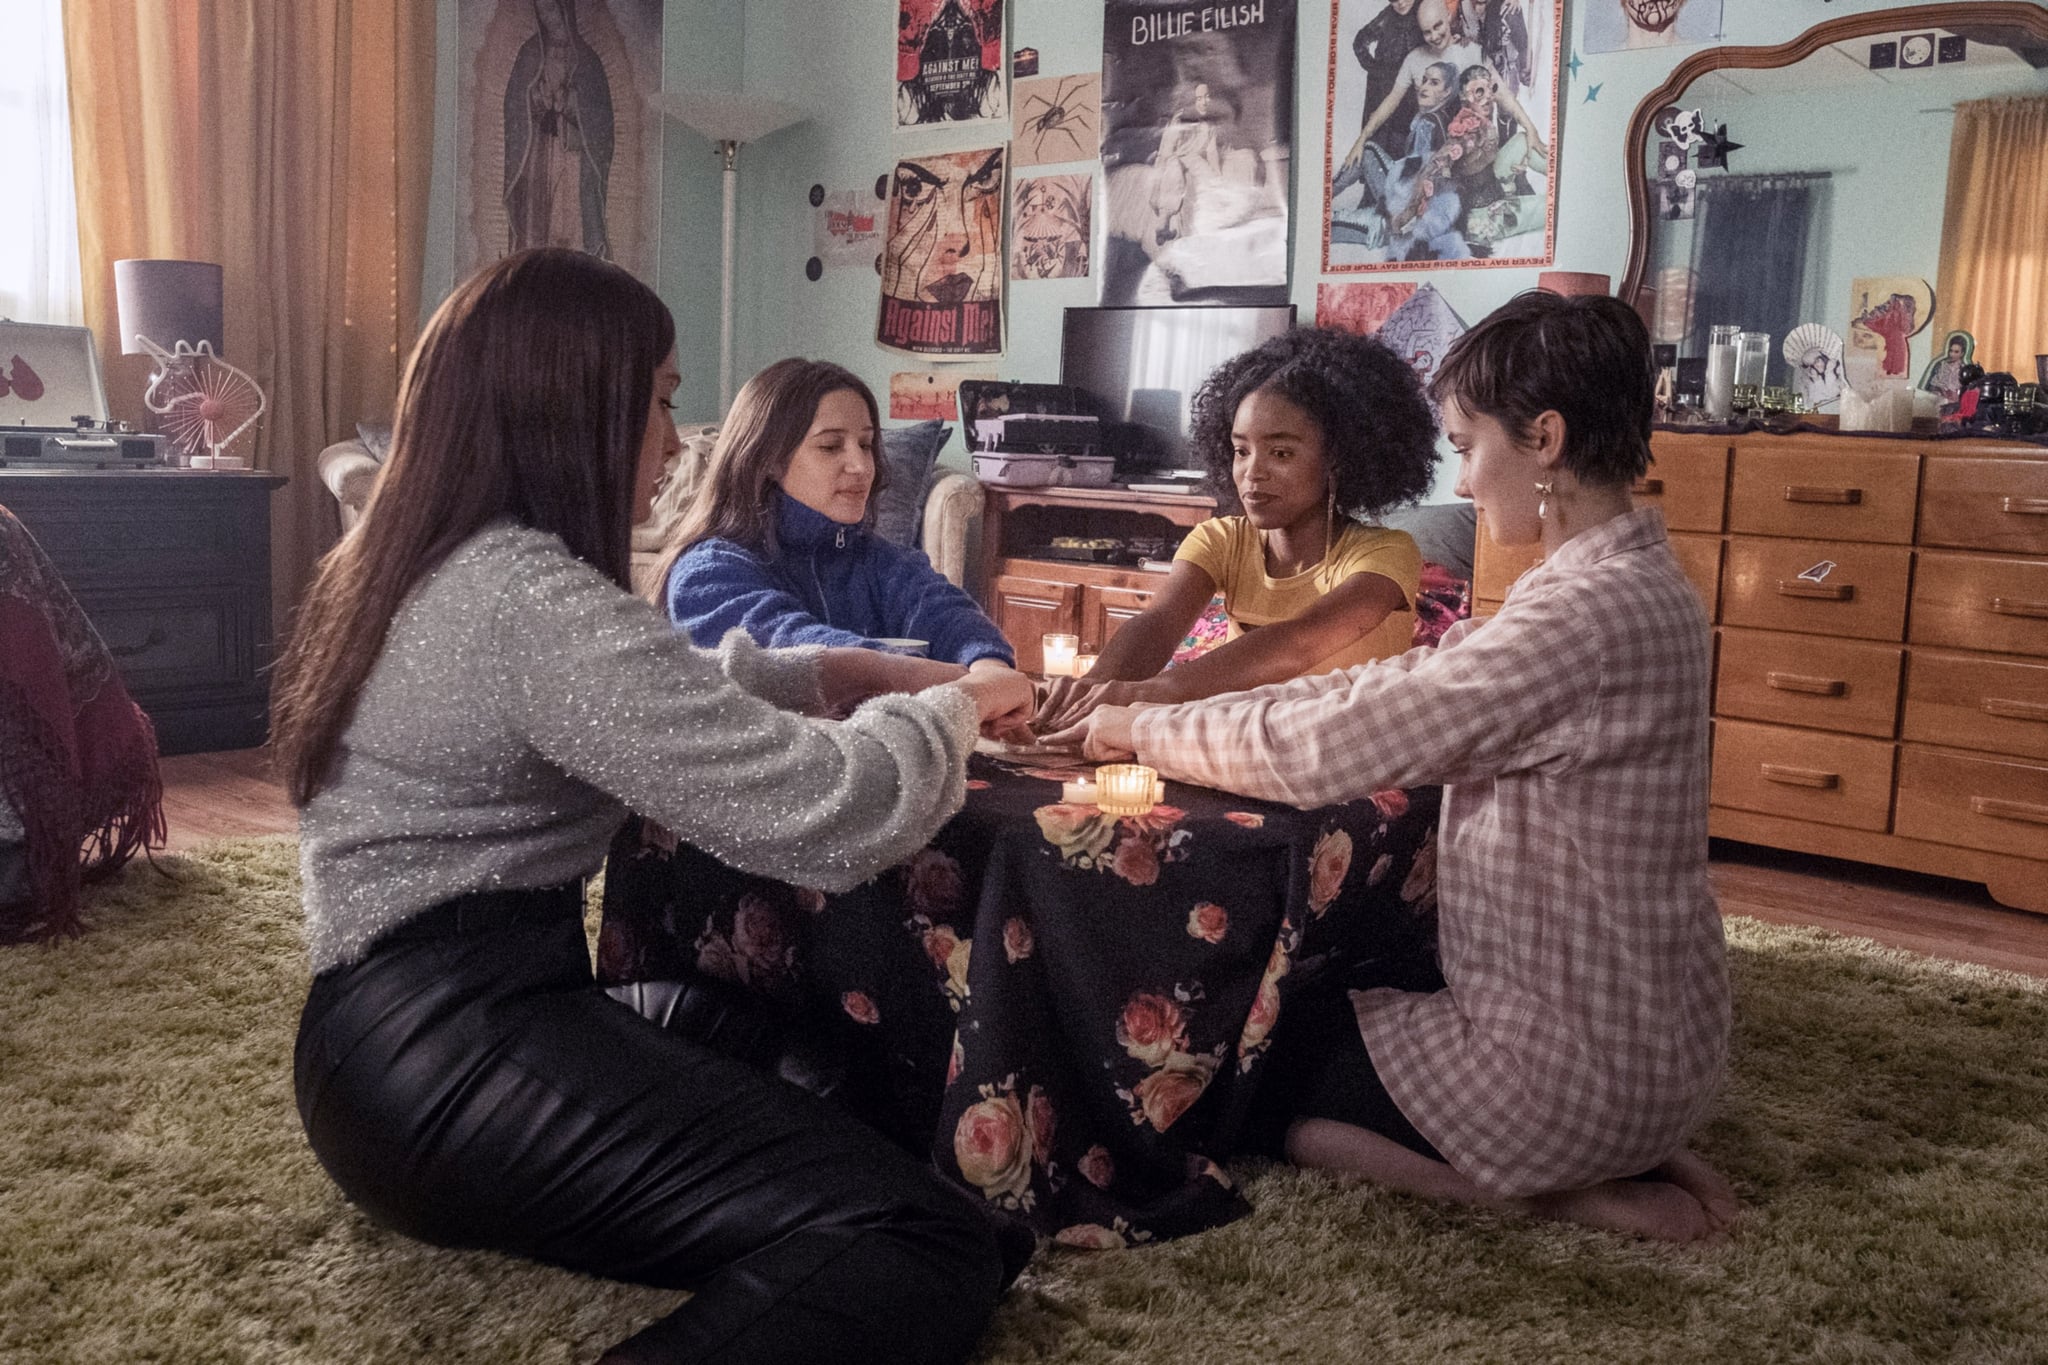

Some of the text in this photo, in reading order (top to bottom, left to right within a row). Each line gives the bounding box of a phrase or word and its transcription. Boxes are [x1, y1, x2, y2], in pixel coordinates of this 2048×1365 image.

[1131, 0, 1264, 45] BILLIE EILISH
[1331, 2, 1339, 35] FEVER
[922, 57, 979, 75] AGAINST ME!
[929, 82, 961, 92] SEPTEMBER
[1401, 261, 1431, 269] FEVER
[1461, 259, 1486, 267] TOUR
[1512, 257, 1545, 265] FEVER
[1354, 263, 1378, 271] TOUR
[884, 299, 957, 345] Against
